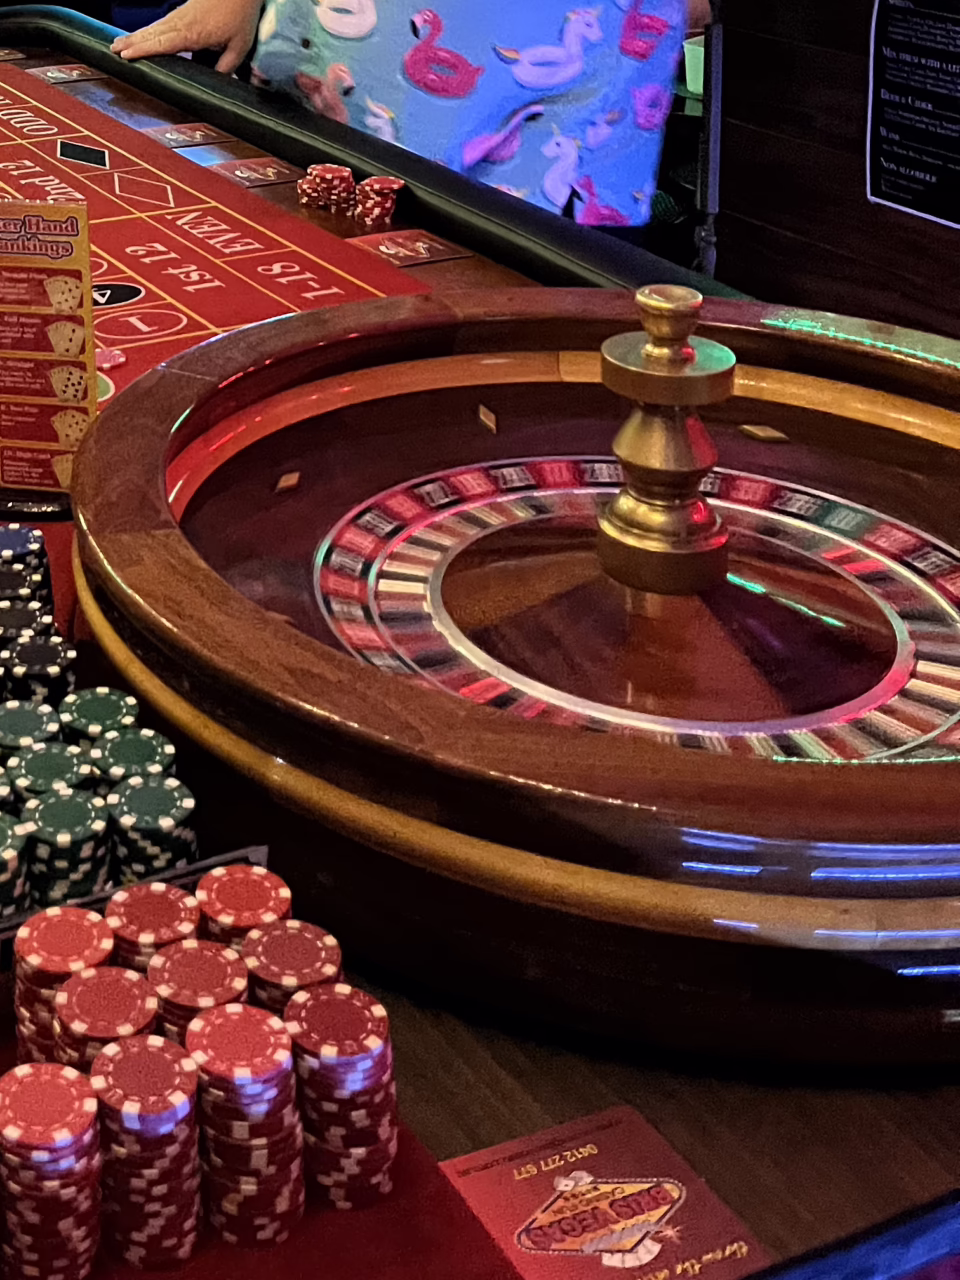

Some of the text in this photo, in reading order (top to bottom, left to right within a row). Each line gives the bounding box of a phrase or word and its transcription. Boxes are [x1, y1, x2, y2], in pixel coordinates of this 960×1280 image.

[24, 215, 79, 236] Hand
[165, 211, 265, 254] EVEN
[125, 242, 226, 293] 1st 12
[257, 261, 345, 300] 1-18
[119, 315, 158, 333] 1
[540, 1153, 564, 1171] 277
[566, 1143, 598, 1163] 0412
[610, 1185, 673, 1220] BRIS
[528, 1206, 621, 1251] VEGAS
